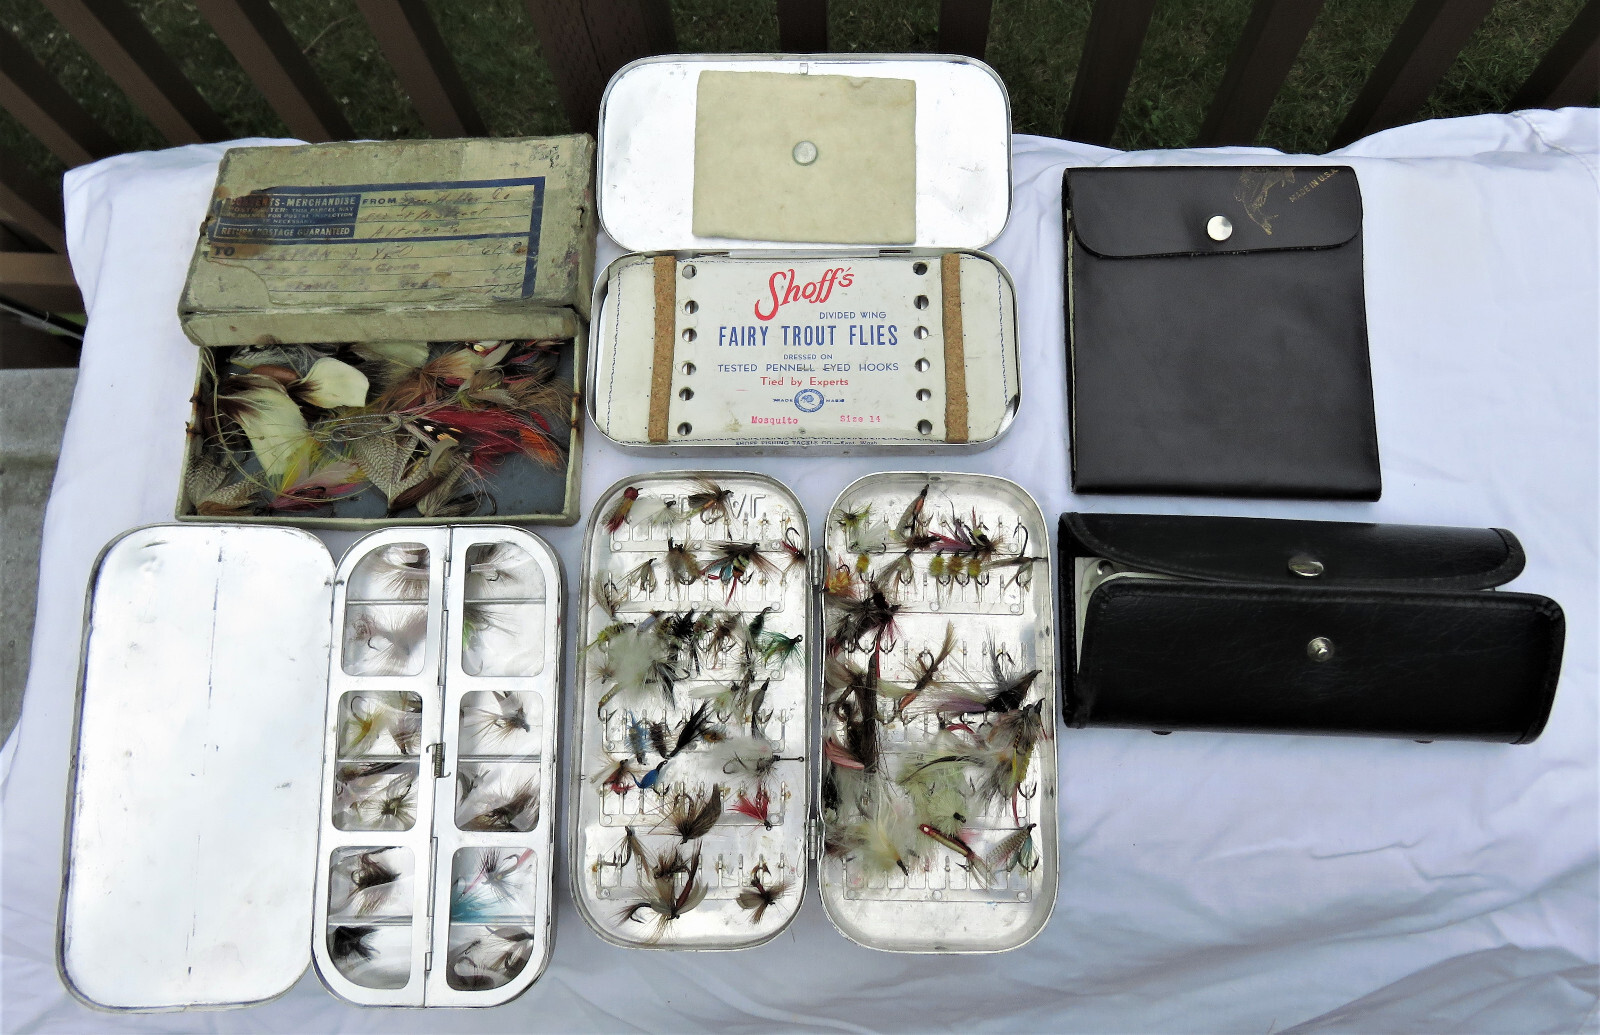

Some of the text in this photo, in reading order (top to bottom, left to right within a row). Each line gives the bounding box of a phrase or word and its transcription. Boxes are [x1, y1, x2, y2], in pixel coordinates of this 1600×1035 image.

[1289, 185, 1310, 202] MADE
[1309, 179, 1319, 188] IN
[362, 197, 397, 206] FROM
[297, 226, 350, 237] GUARANTEED
[214, 246, 236, 257] TO
[754, 267, 855, 321] Shoff's
[819, 311, 887, 320] DIVIDED WING
[718, 324, 898, 347] FAIRY TROUT FLIES
[717, 362, 899, 372] TESTED PENNELL EYED HOOKS
[760, 376, 849, 388] Tied by Experts
[751, 415, 881, 425] Mosquito Size 14
